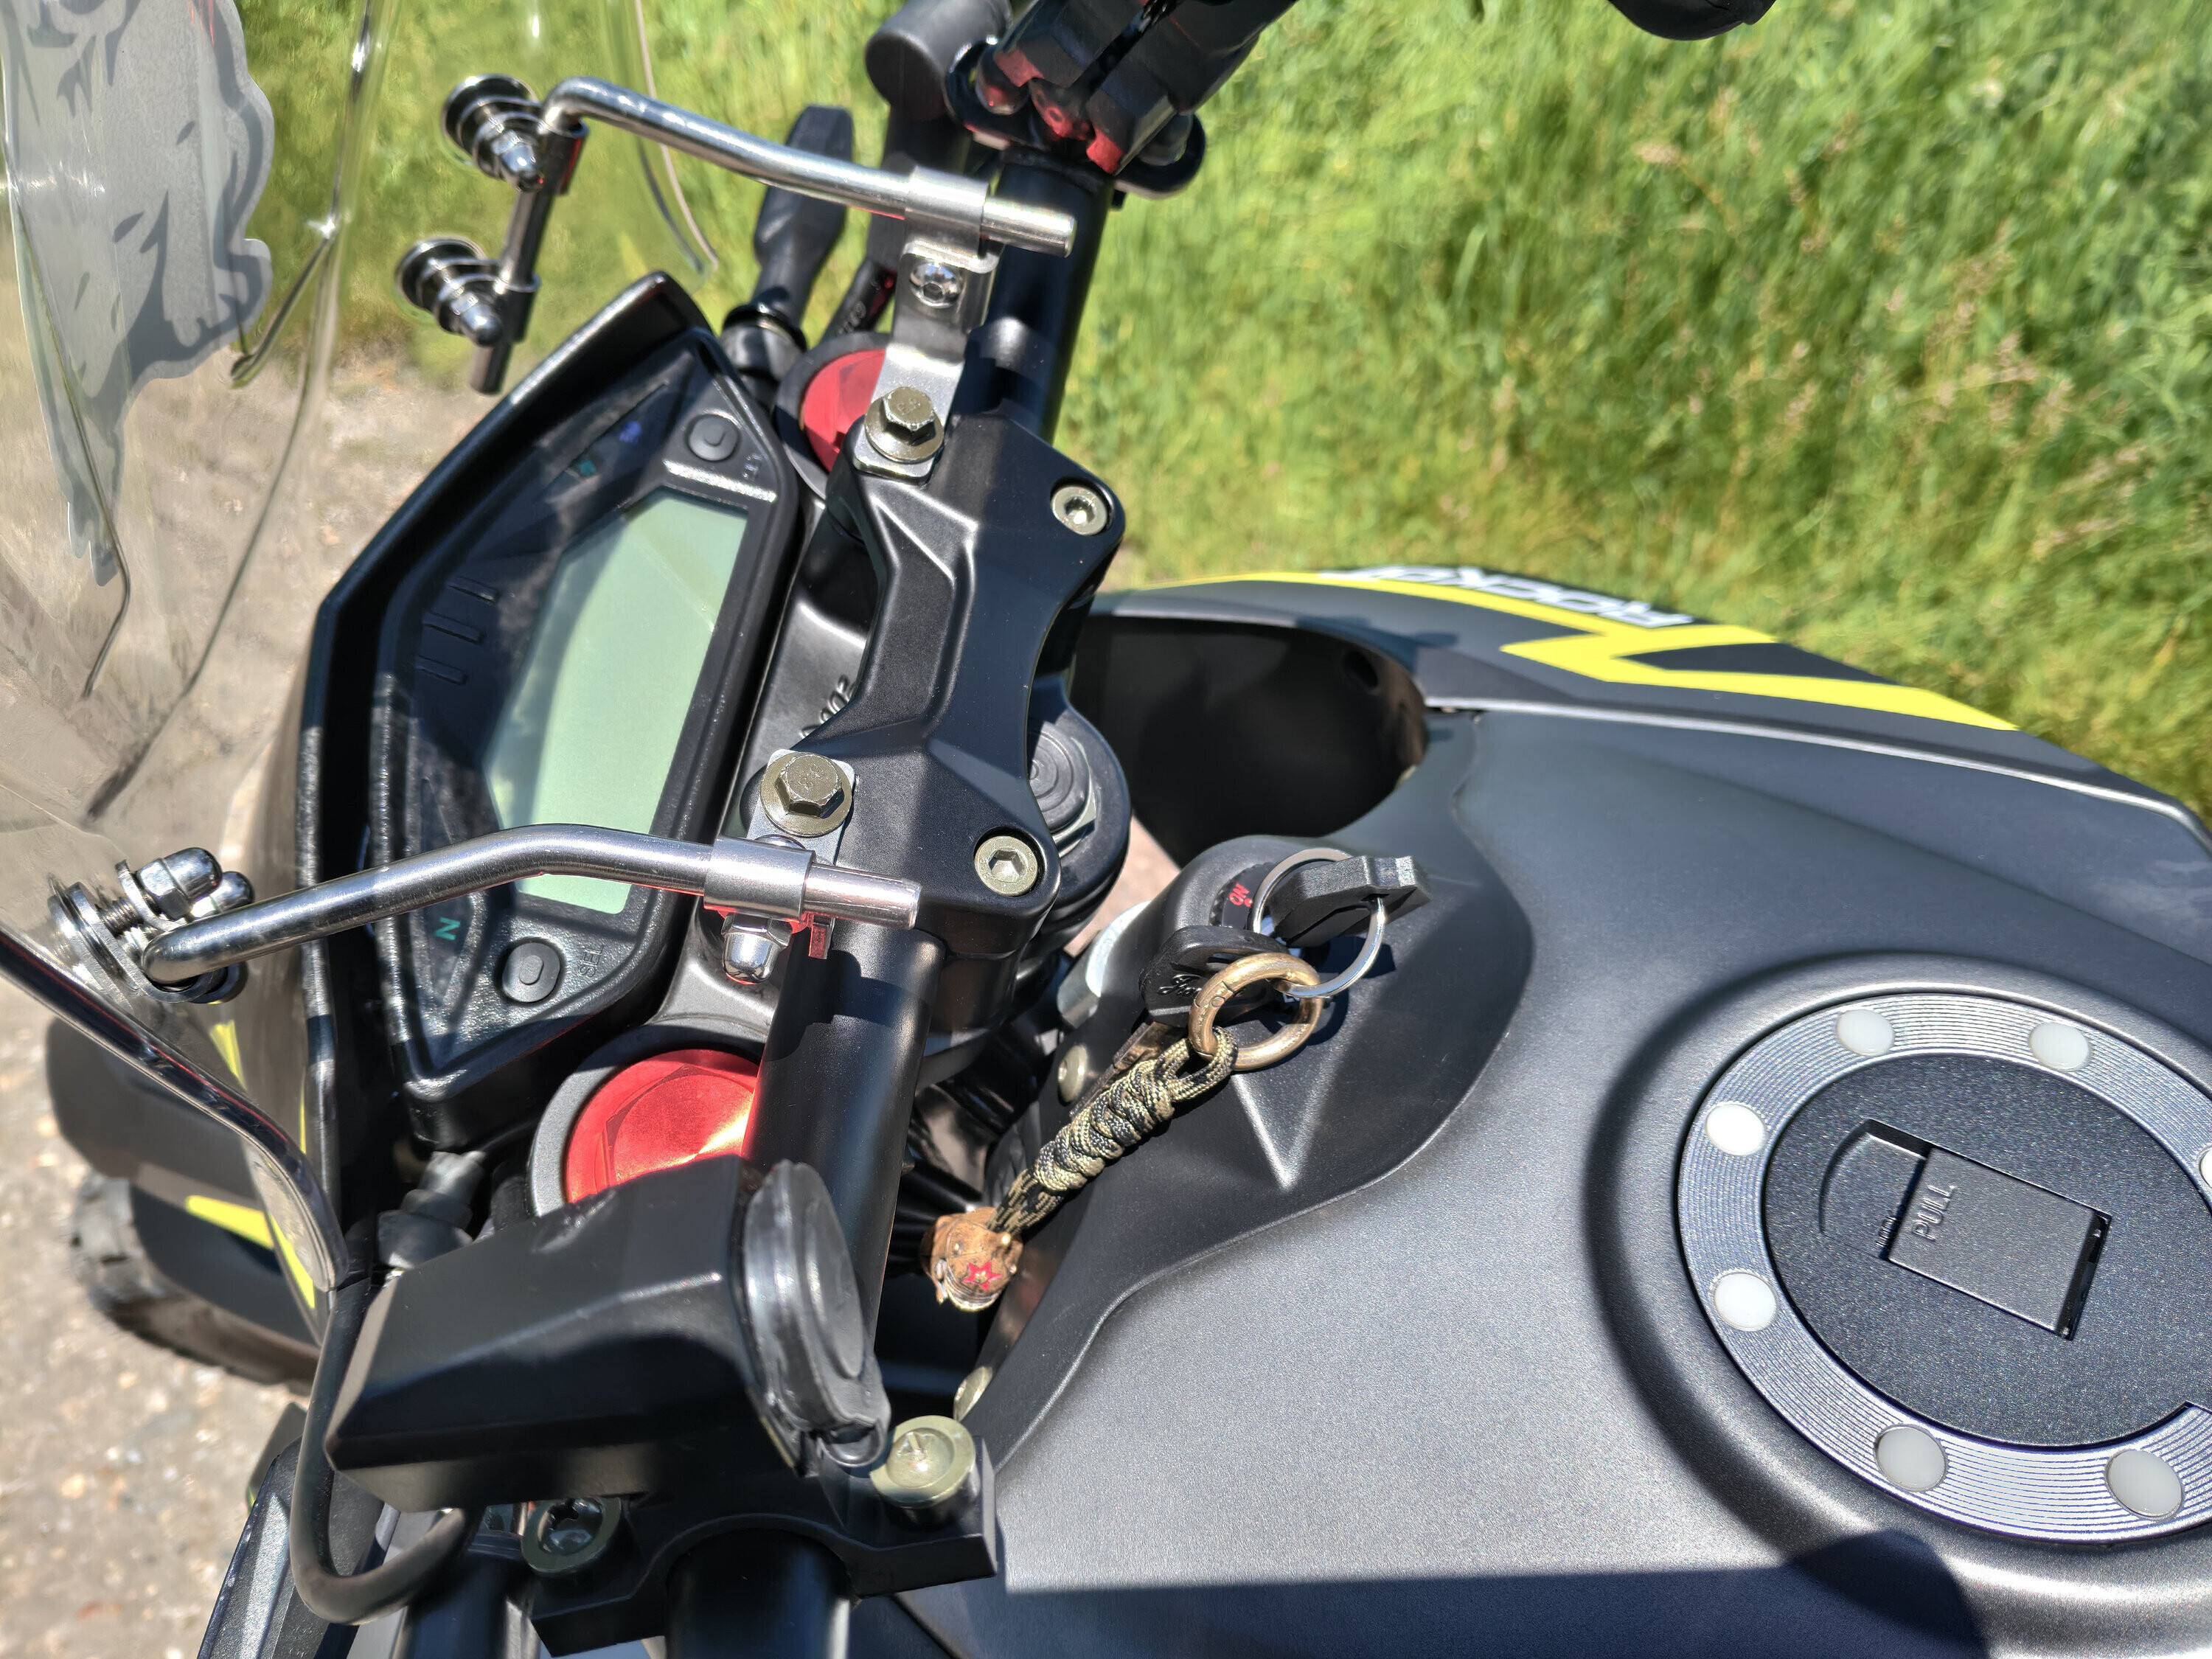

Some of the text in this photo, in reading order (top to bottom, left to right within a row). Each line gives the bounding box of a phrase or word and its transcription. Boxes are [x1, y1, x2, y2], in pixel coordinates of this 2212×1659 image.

[1229, 883, 1250, 906] ON
[435, 917, 461, 941] N
[578, 943, 605, 978] SEL
[1911, 1184, 1958, 1242] PULL
